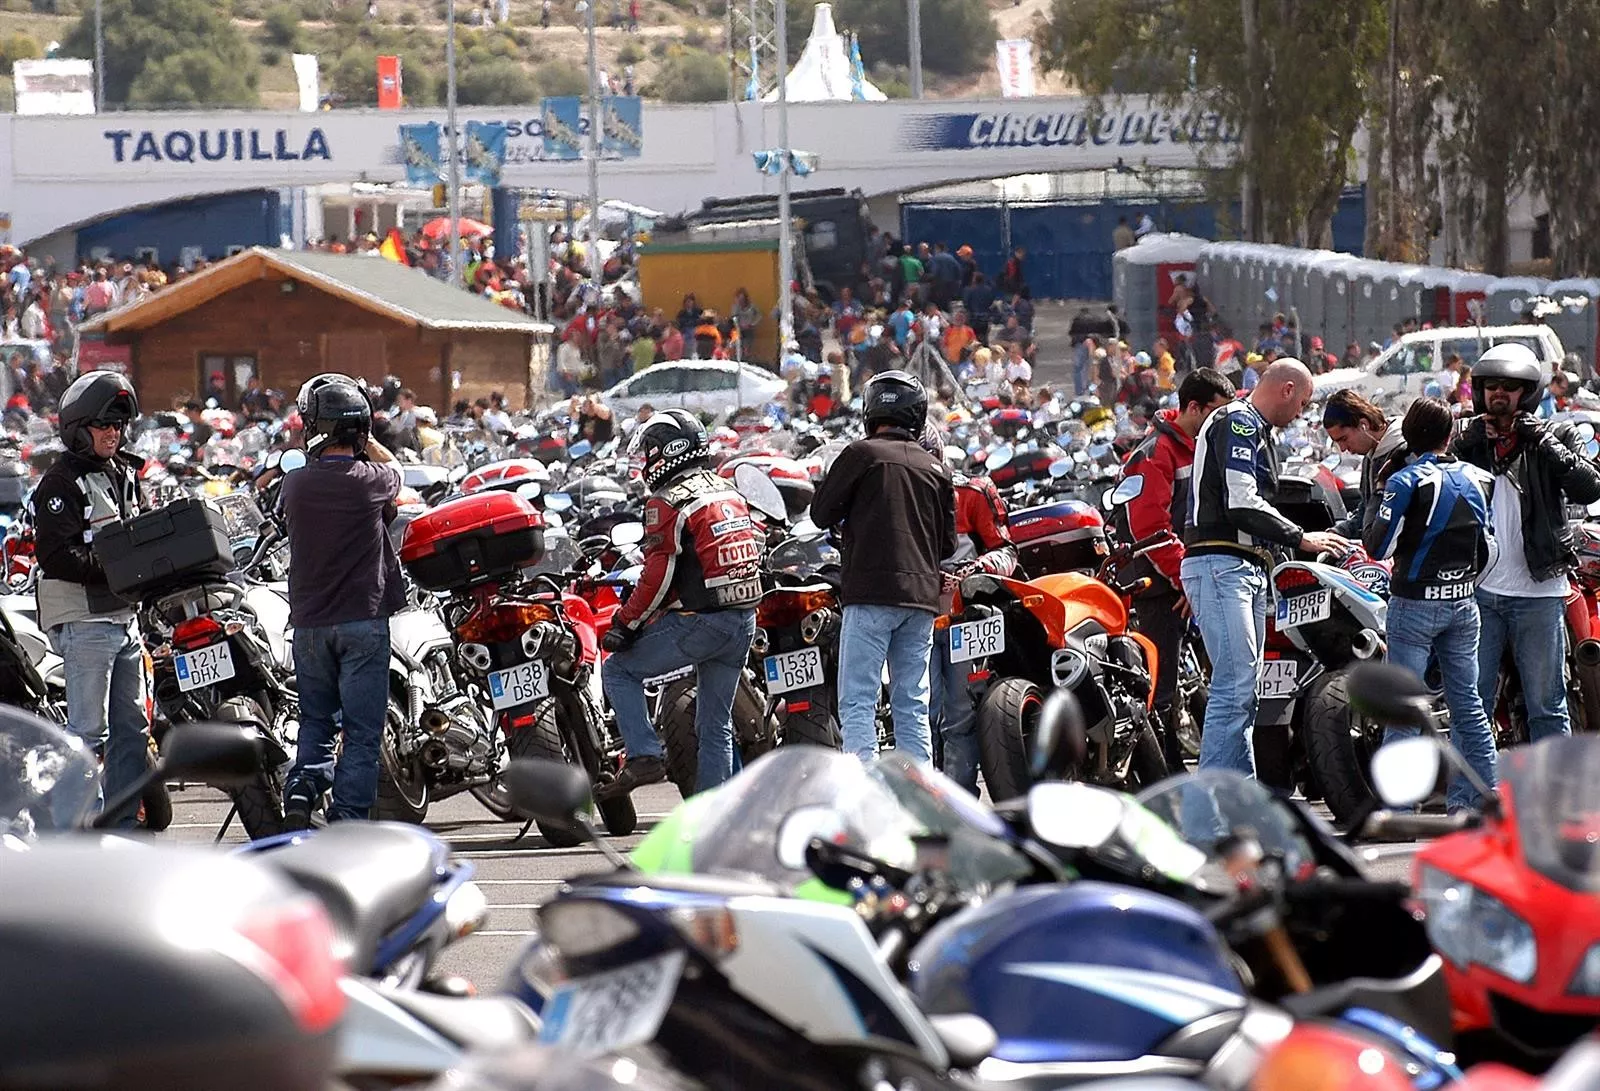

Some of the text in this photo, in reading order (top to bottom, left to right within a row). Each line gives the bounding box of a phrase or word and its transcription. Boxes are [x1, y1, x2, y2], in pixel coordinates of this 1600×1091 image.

[104, 127, 332, 163] TAQUILLA
[665, 440, 688, 455] Arai
[717, 580, 763, 603] MOTU
[1424, 579, 1475, 600] BERIK
[1289, 590, 1327, 612] 8086
[1289, 604, 1320, 625] DPM
[963, 619, 1001, 641] 5106
[190, 645, 228, 669] 1214
[968, 636, 997, 656] FXR
[779, 650, 818, 673] 1533
[1263, 662, 1293, 678] 714
[190, 663, 221, 685] DHX
[501, 663, 542, 689] 7138
[784, 666, 815, 688] DSM
[513, 680, 542, 702] DSK
